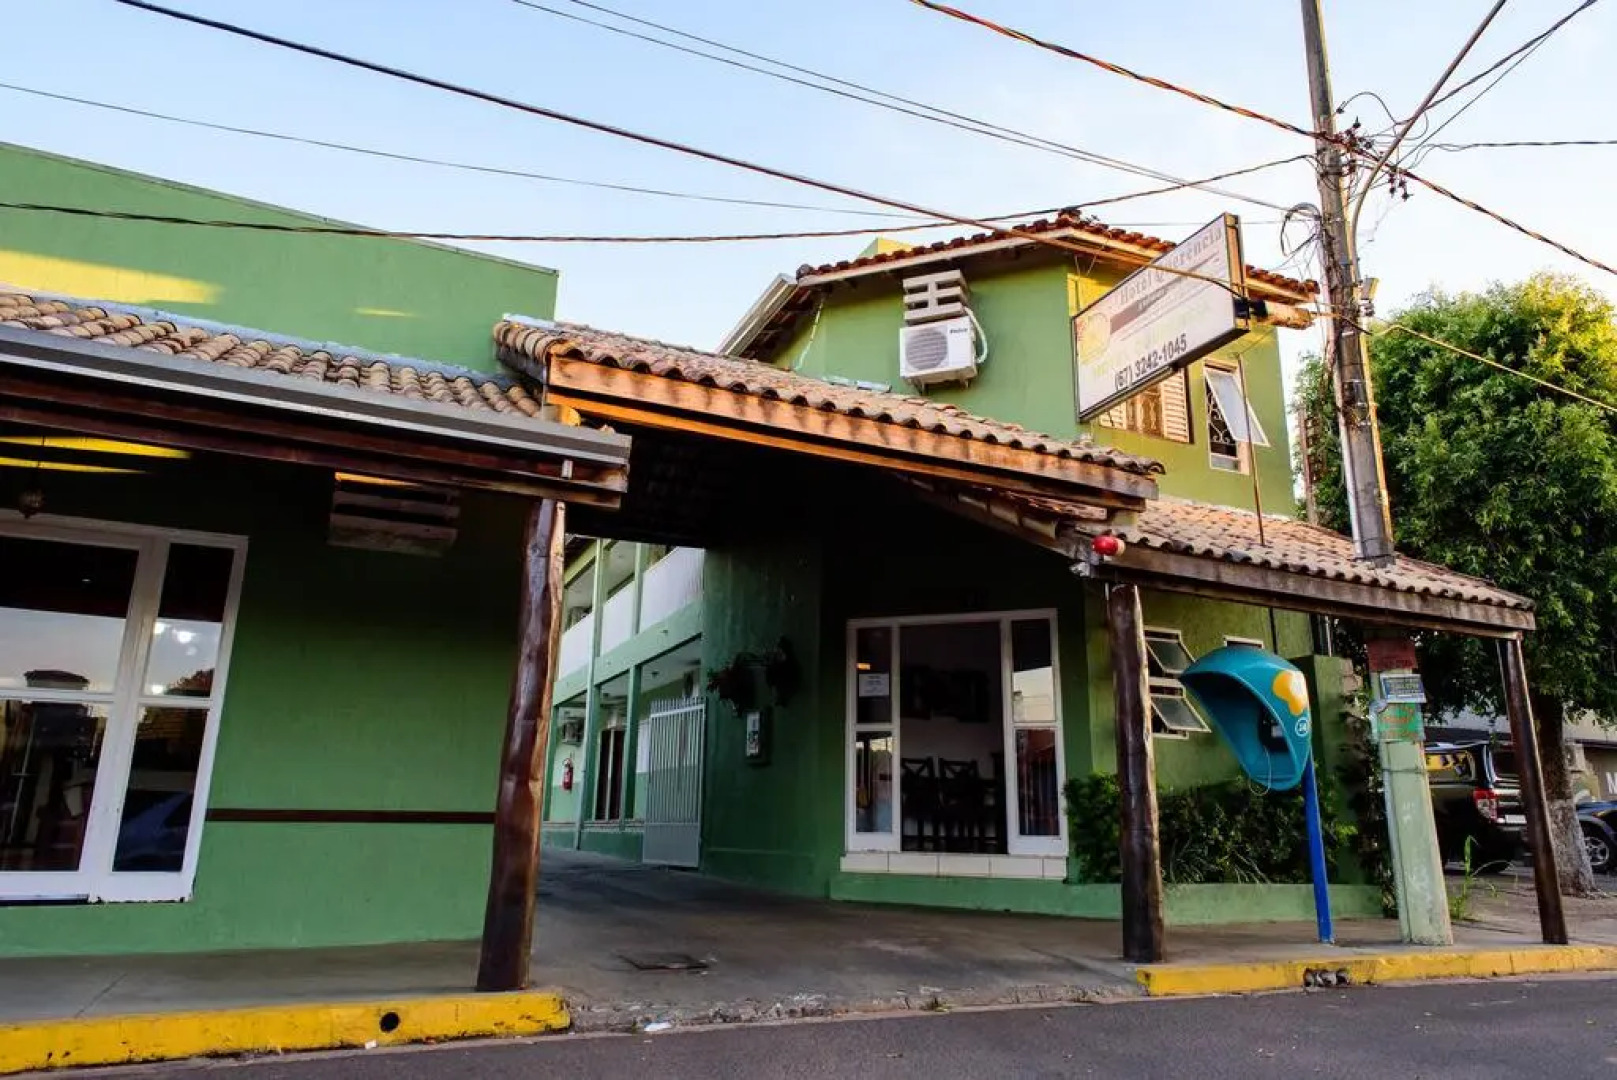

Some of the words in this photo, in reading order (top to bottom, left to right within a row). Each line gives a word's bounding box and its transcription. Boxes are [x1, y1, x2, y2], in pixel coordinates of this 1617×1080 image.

[1120, 269, 1151, 305] Hotel
[1115, 365, 1132, 391] (67)
[1135, 333, 1187, 378] 3242-1045
